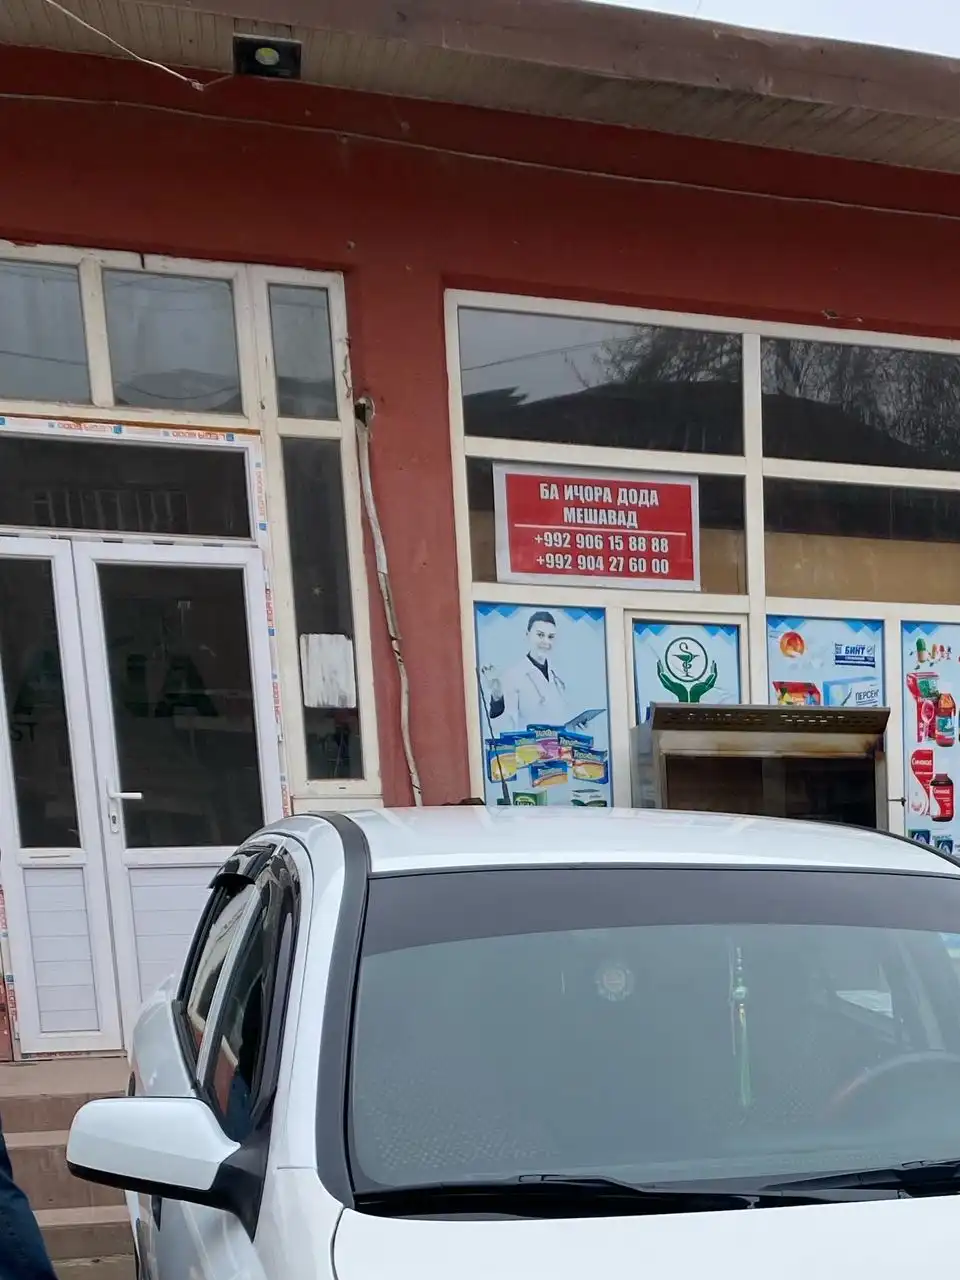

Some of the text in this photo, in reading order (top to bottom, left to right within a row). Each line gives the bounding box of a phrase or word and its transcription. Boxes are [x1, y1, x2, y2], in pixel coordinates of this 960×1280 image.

[540, 483, 560, 499] БА
[617, 487, 659, 507] ДОДА
[563, 507, 638, 528] МЕШАВАД
[534, 532, 669, 553] +992 906 15 88 88
[536, 554, 669, 574] +992 904 27 60 00
[844, 646, 866, 655] БИНТ
